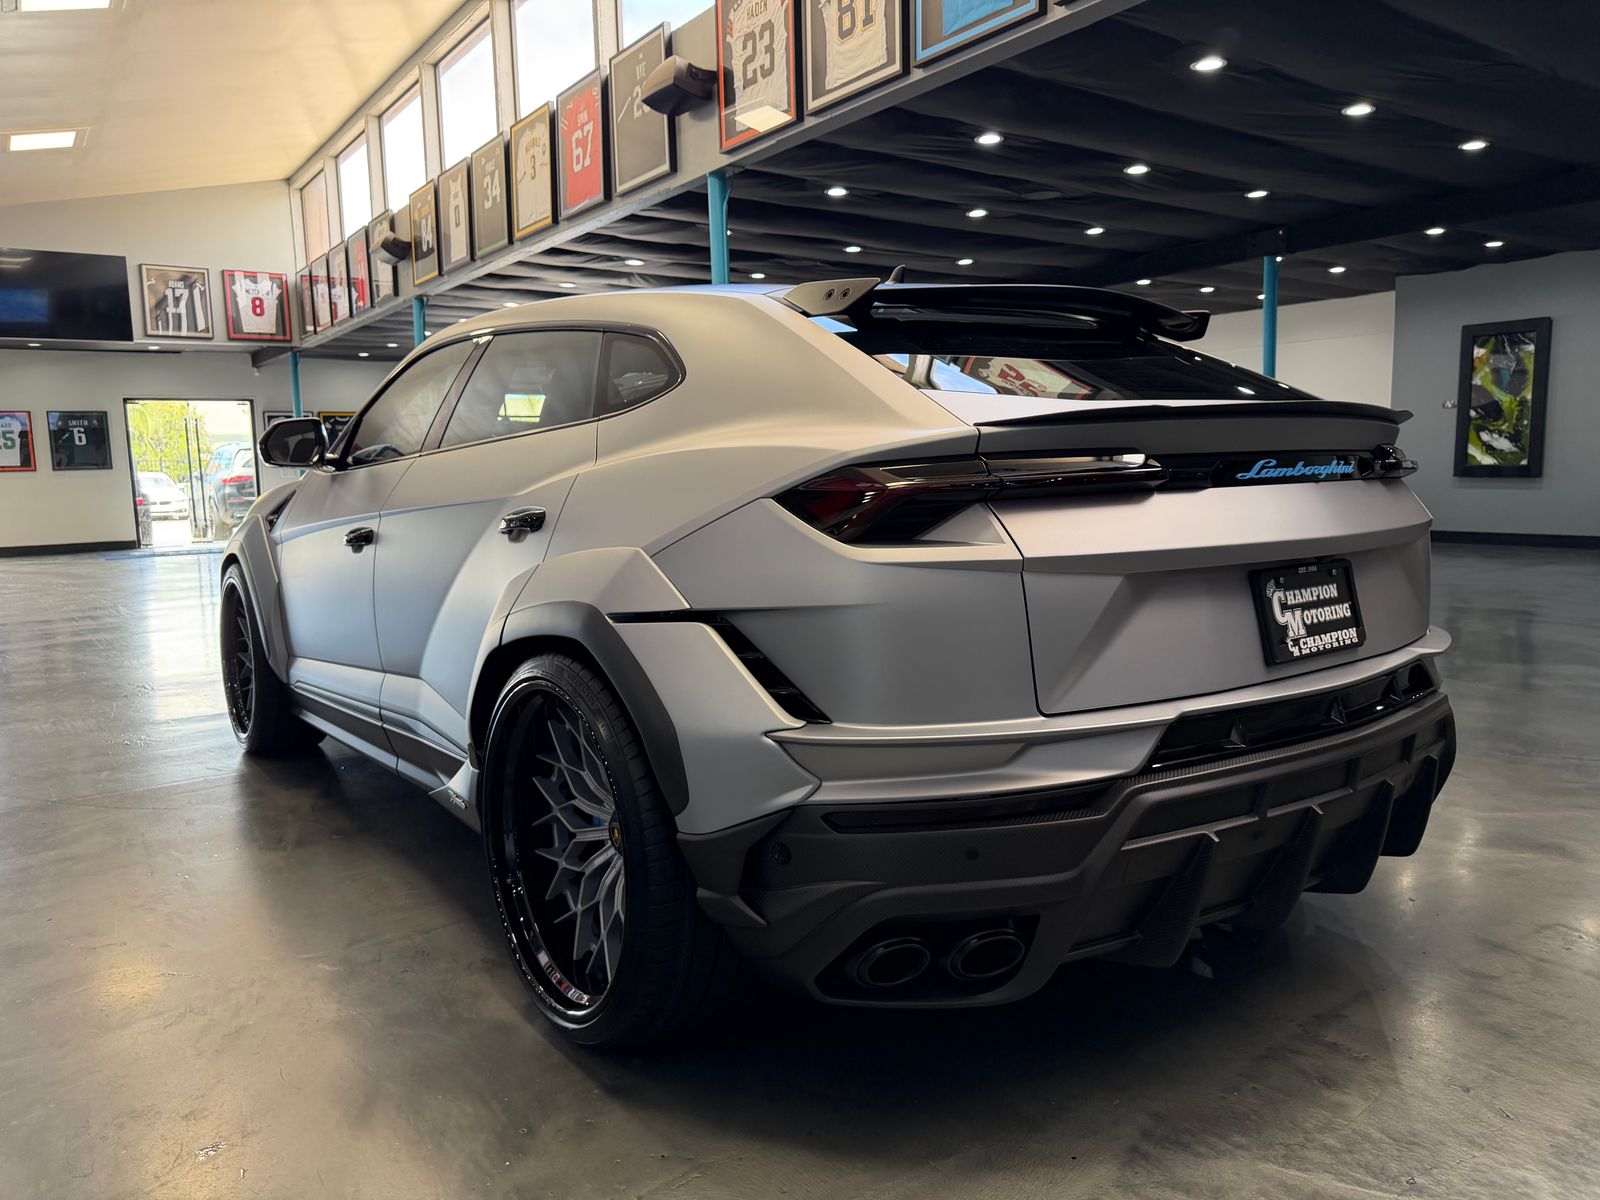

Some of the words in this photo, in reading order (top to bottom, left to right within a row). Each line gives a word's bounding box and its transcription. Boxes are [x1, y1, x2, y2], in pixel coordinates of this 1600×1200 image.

[742, 19, 775, 90] 23
[572, 121, 594, 173] 67
[530, 154, 537, 180] 3
[483, 169, 501, 210] 34
[421, 214, 433, 253] 84
[251, 296, 266, 317] 8
[68, 419, 89, 427] SMITH
[73, 427, 88, 446] 6
[1235, 458, 1355, 480] Lamborghini
[1272, 583, 1339, 626] CHAMPION
[1283, 603, 1352, 640] MOTORING
[1300, 627, 1358, 650] CHAMPION
[1301, 637, 1359, 656] MOTORING
